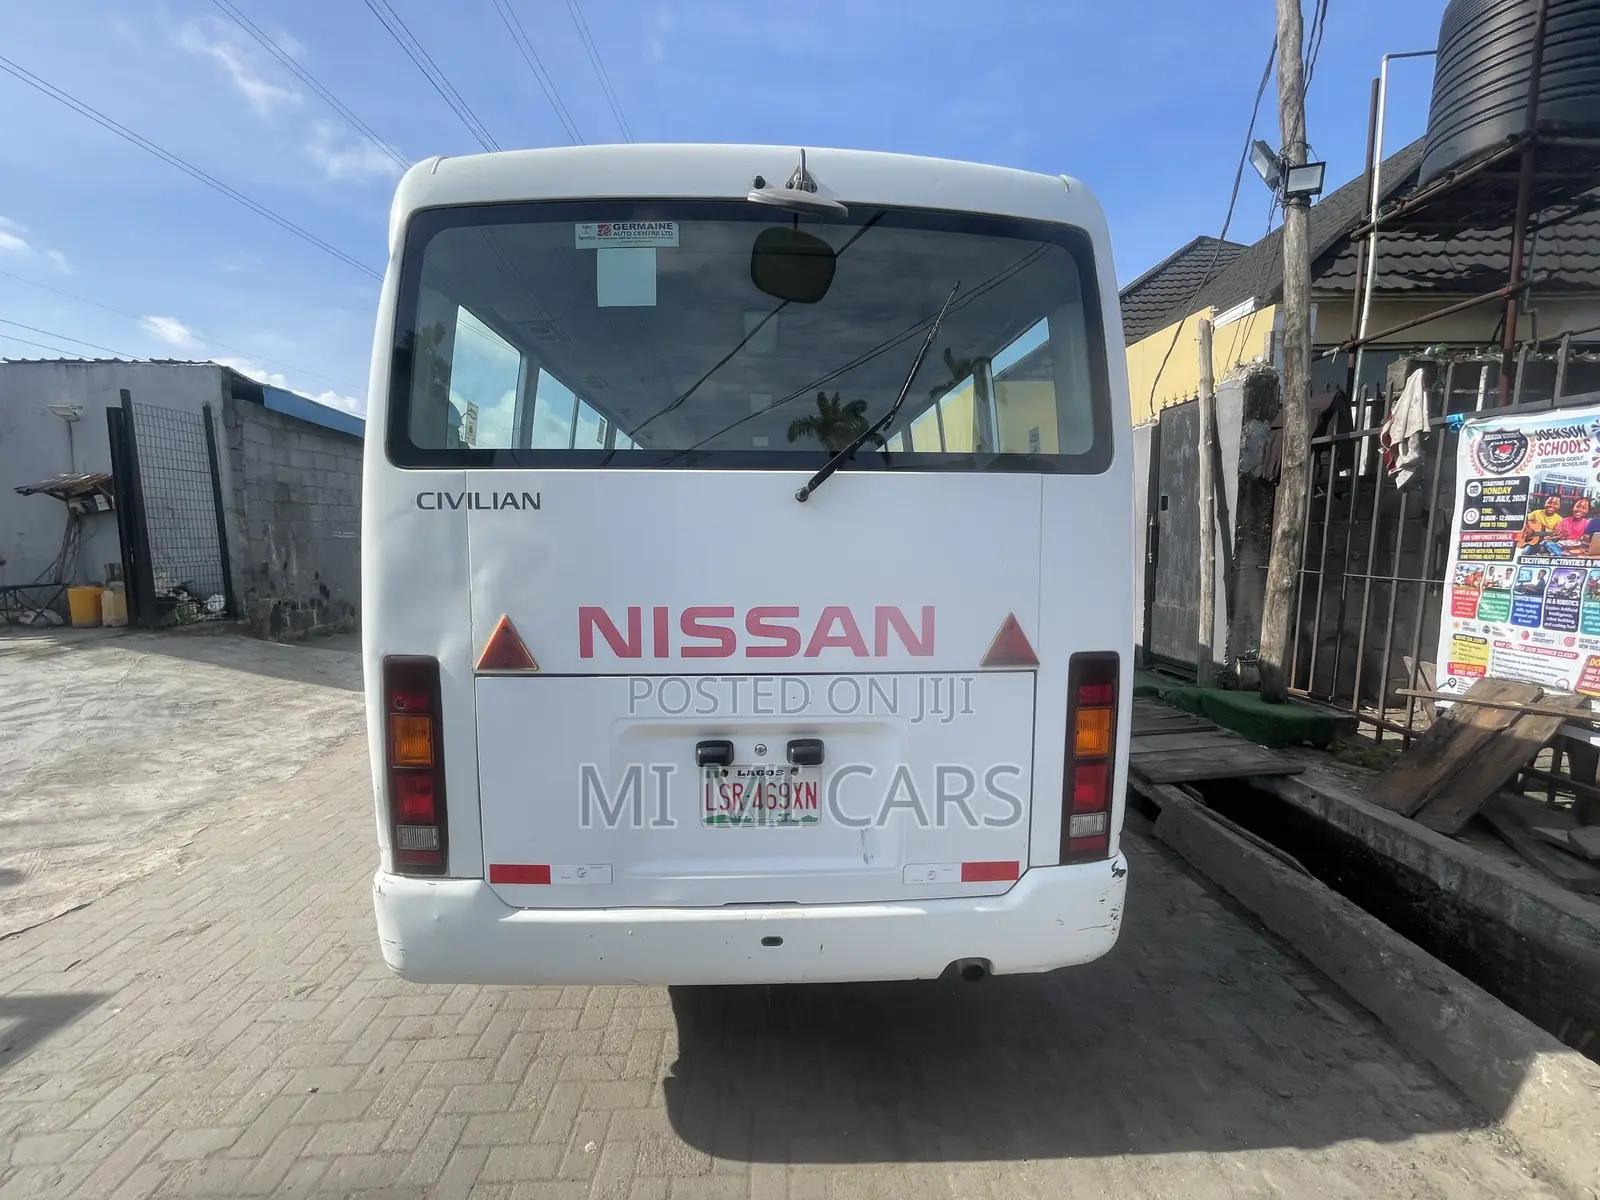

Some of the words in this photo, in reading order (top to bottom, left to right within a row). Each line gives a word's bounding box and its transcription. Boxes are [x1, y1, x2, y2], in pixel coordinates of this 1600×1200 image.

[613, 222, 673, 231] GERMAINE
[1535, 424, 1587, 441] JOEKSON
[1537, 438, 1591, 457] SCHOOLS
[1482, 486, 1512, 495] MONDAY
[416, 492, 541, 510] CIVILIAN
[1520, 557, 1549, 565] EXCITING
[1550, 558, 1586, 567] ACTIVITIES
[578, 605, 935, 659] NISSAN
[737, 769, 785, 777] LAGOS
